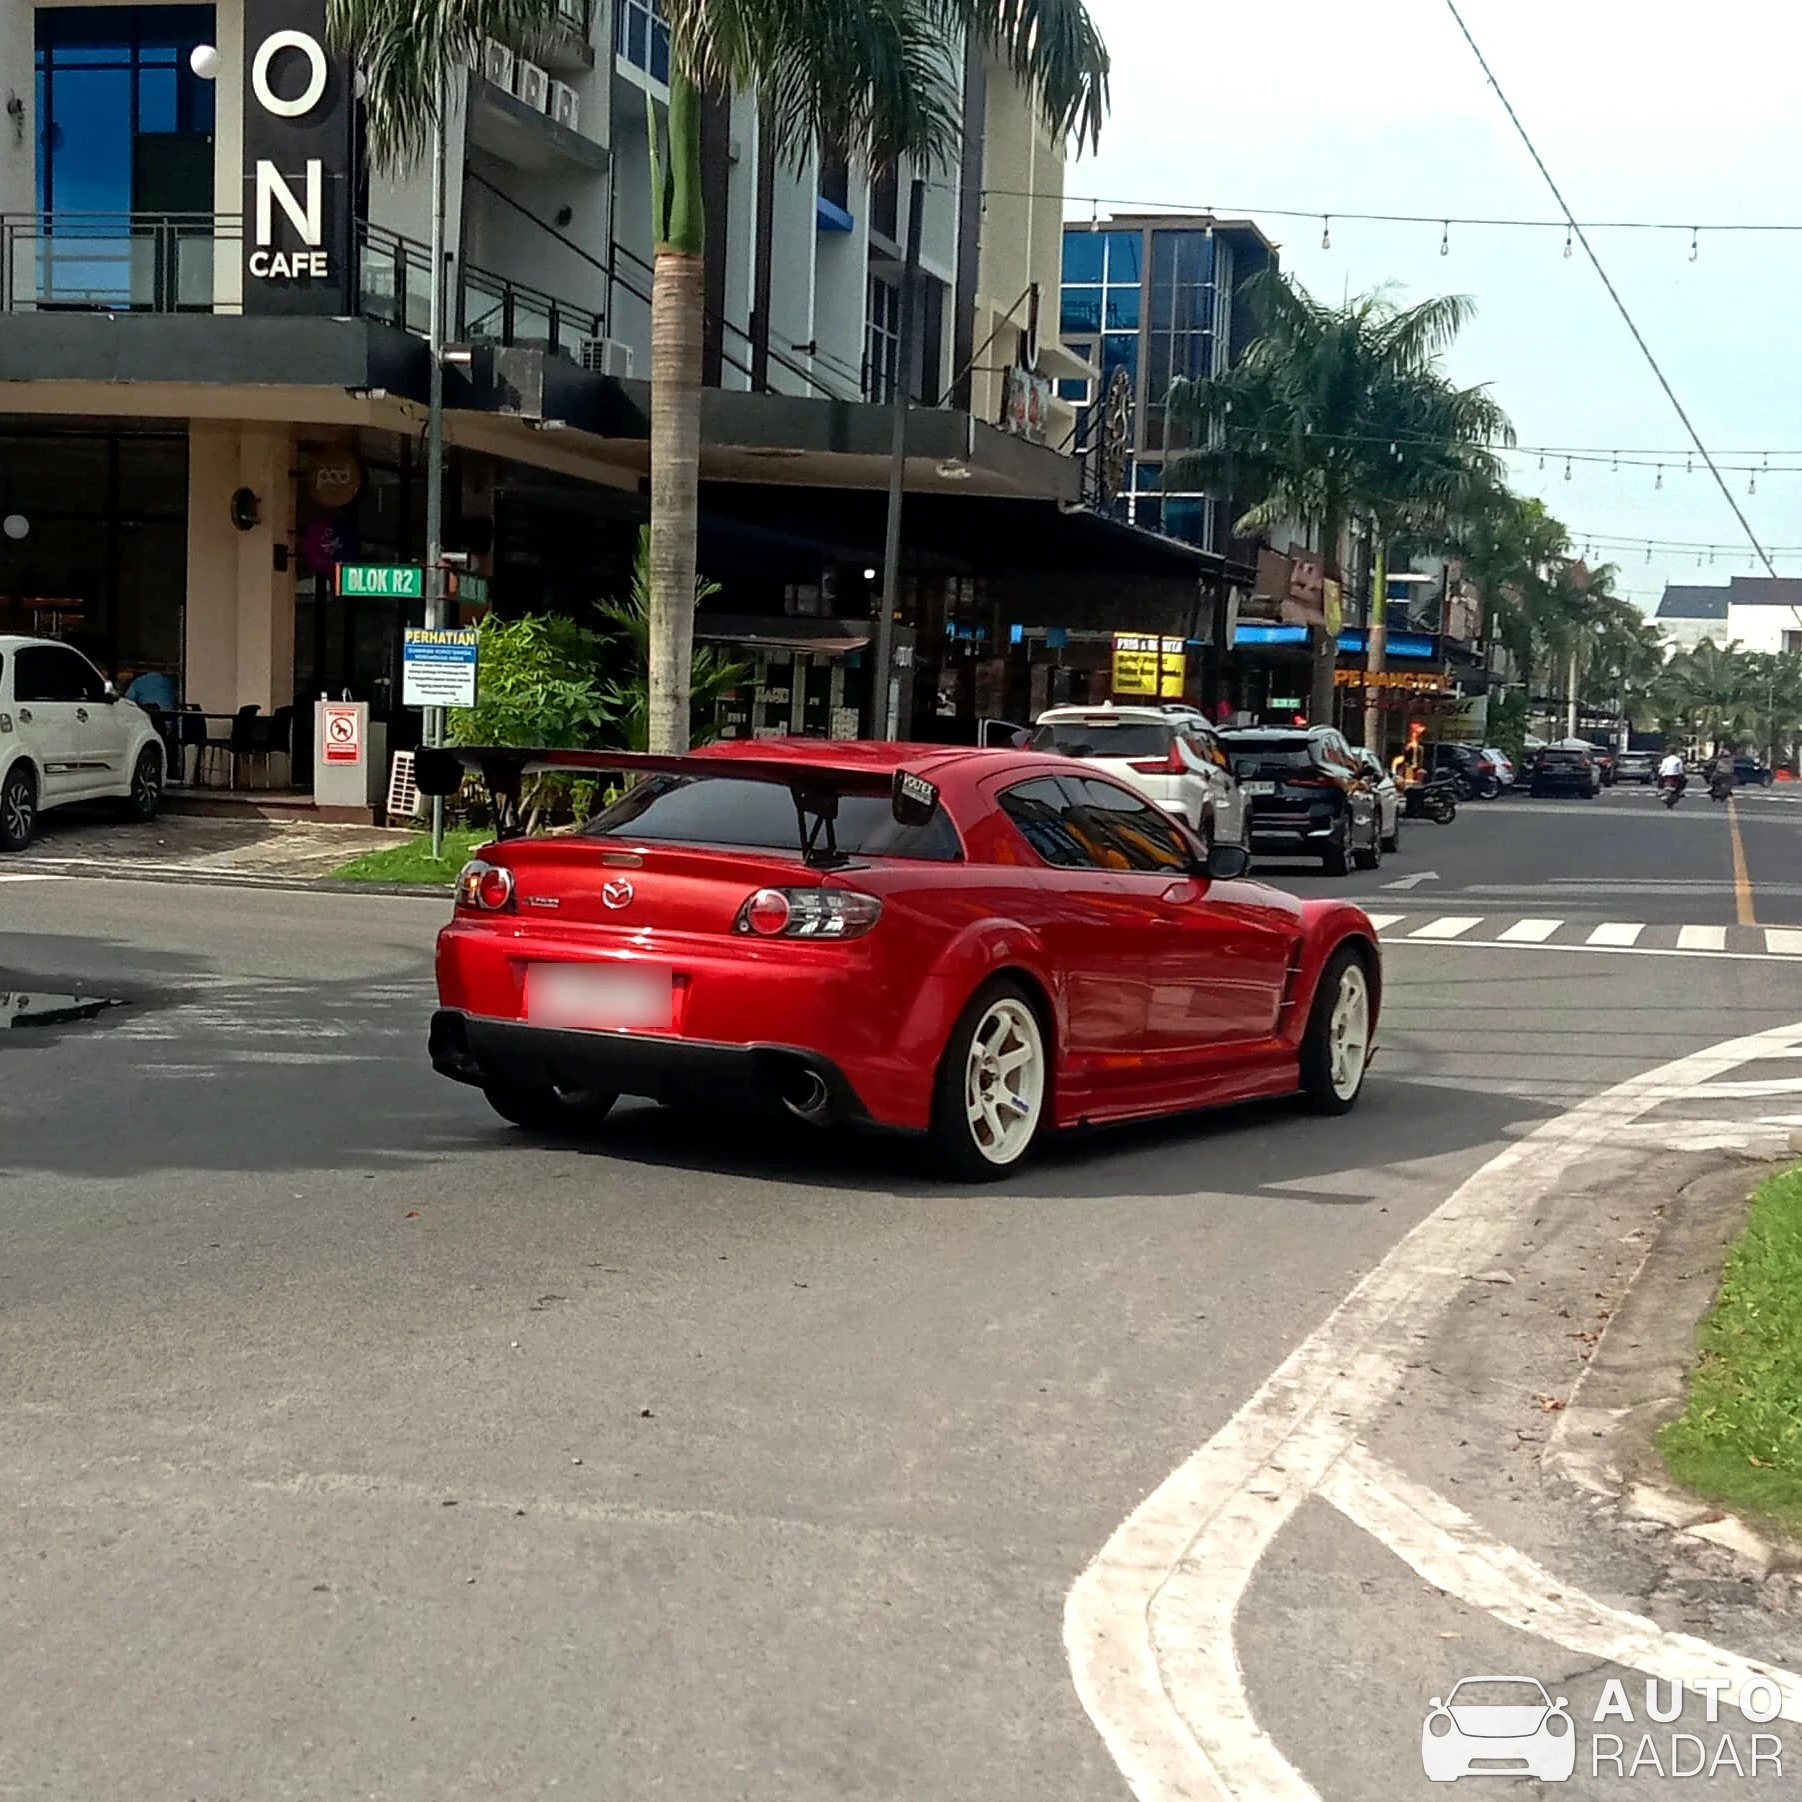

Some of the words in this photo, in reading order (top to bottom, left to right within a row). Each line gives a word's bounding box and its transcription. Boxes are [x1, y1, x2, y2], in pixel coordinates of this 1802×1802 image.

[249, 252, 328, 278] CAFE
[348, 568, 387, 593] BLOK
[393, 569, 413, 593] R2
[405, 630, 475, 645] PERHATIAN
